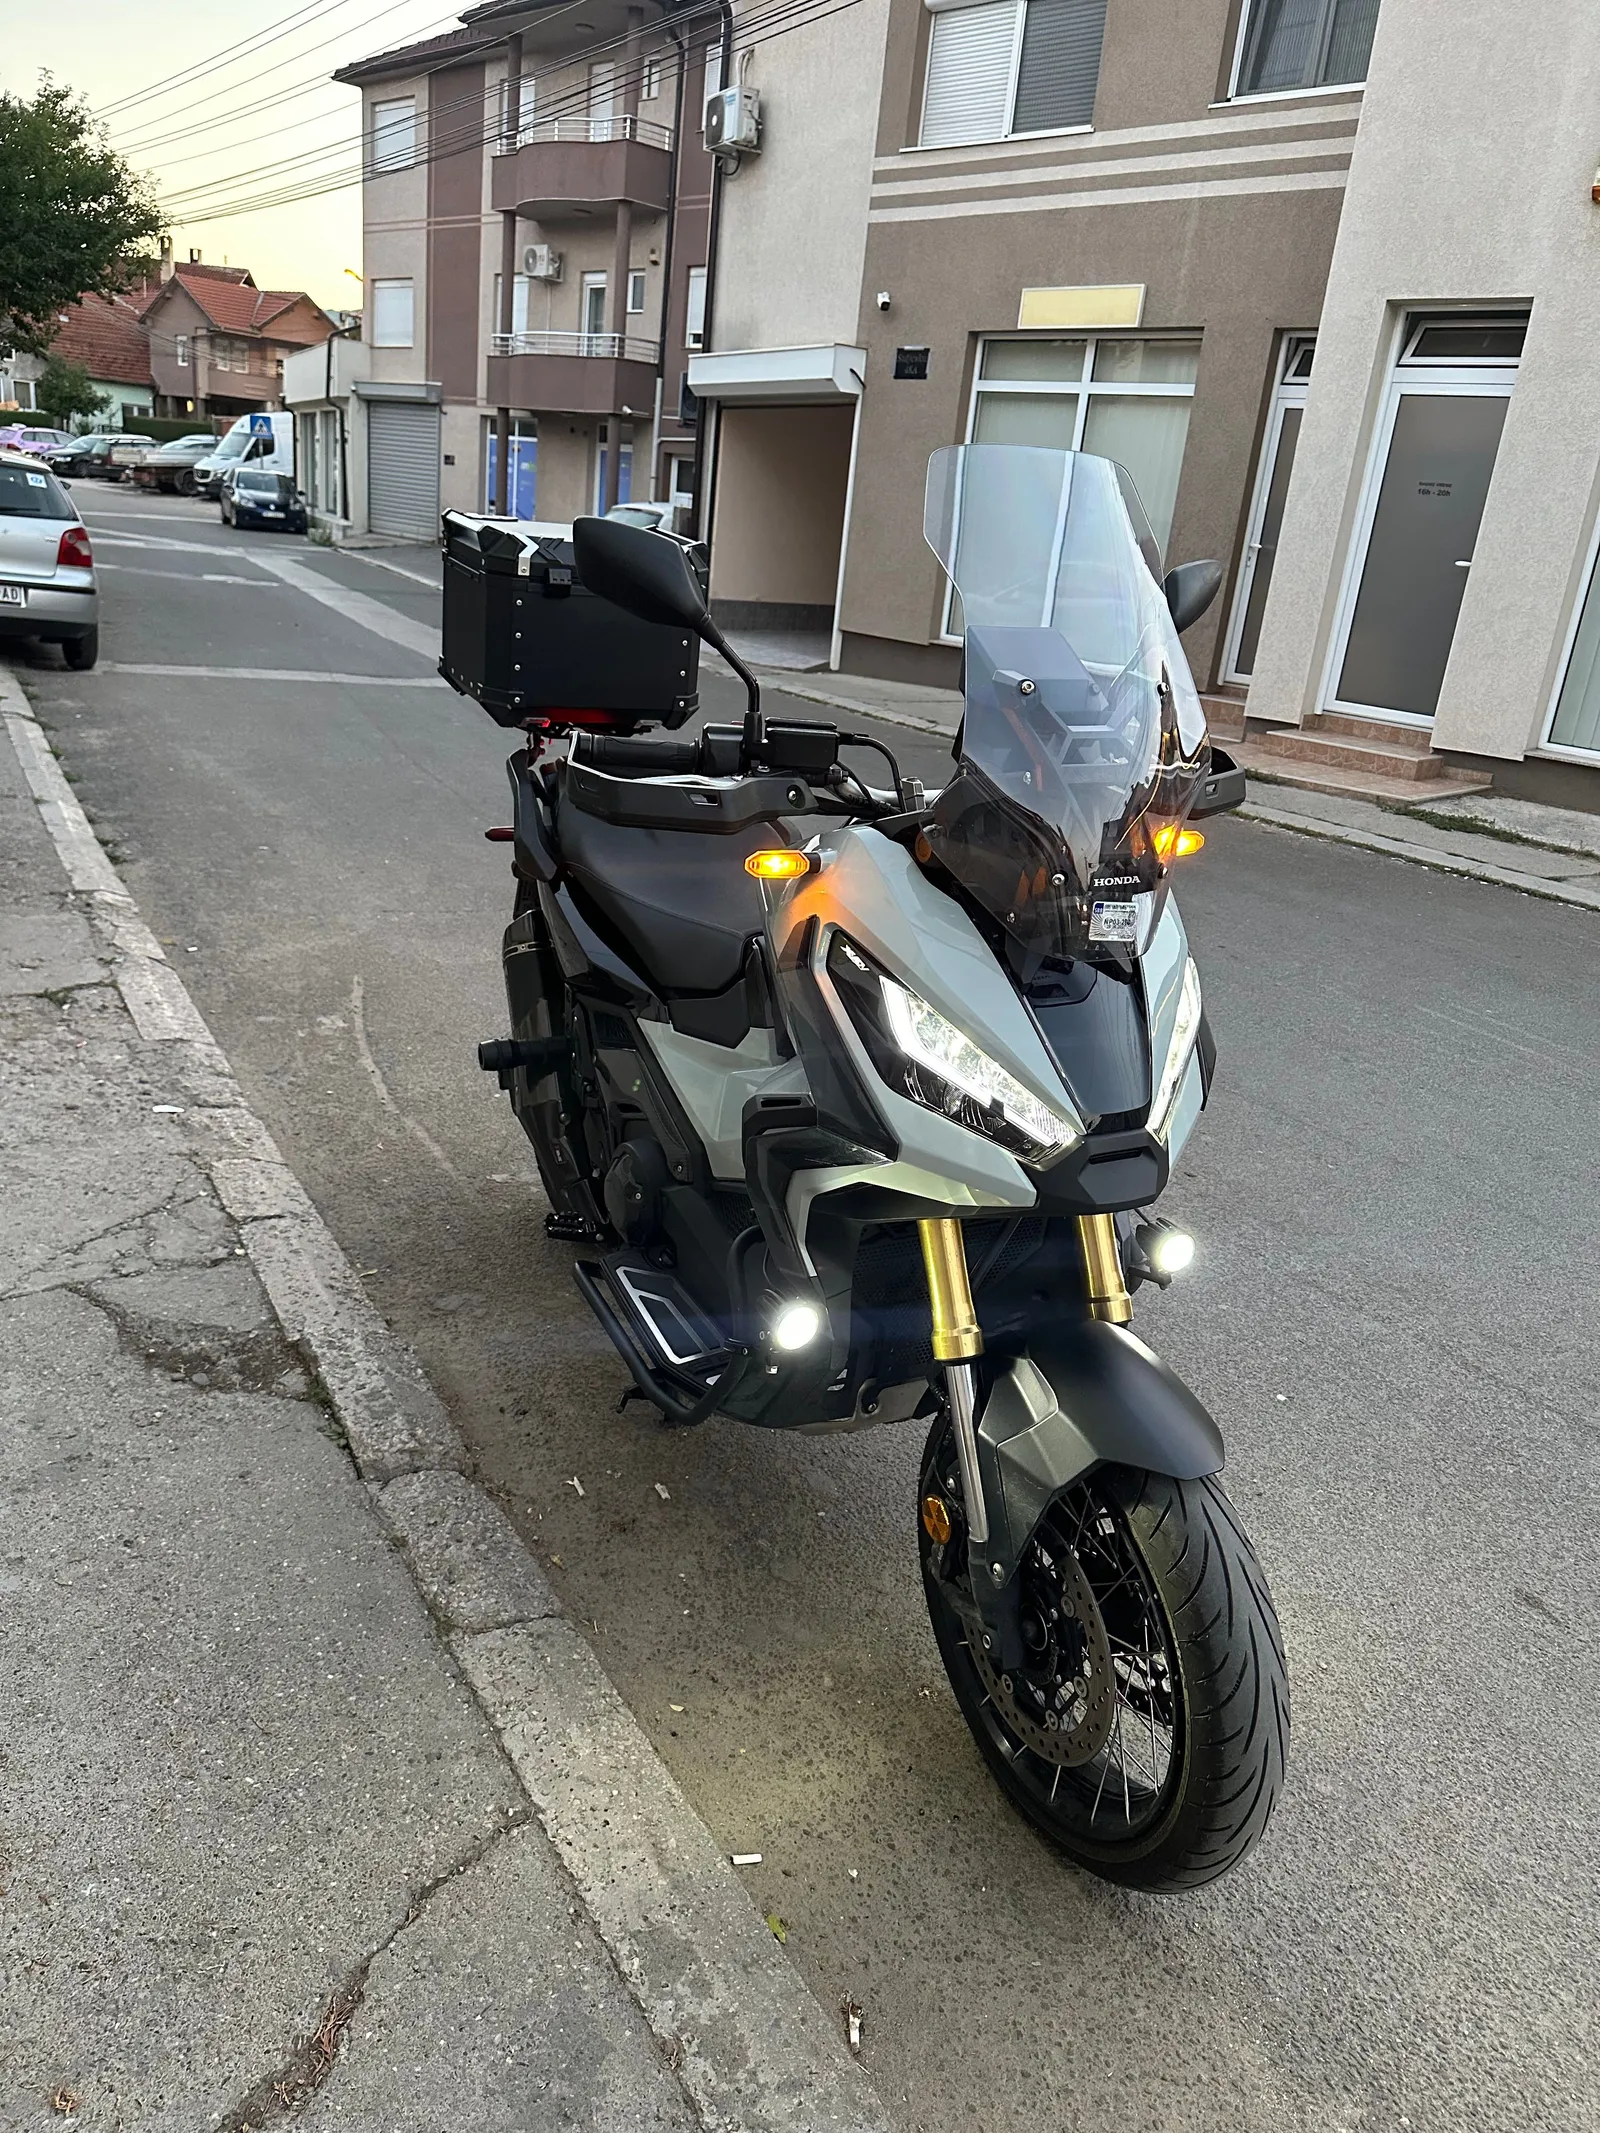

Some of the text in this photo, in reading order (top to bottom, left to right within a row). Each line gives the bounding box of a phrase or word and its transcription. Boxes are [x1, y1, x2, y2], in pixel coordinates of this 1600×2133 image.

[1418, 488, 1431, 496] 16h
[1436, 489, 1451, 497] 20h
[1093, 876, 1141, 887] HONDA
